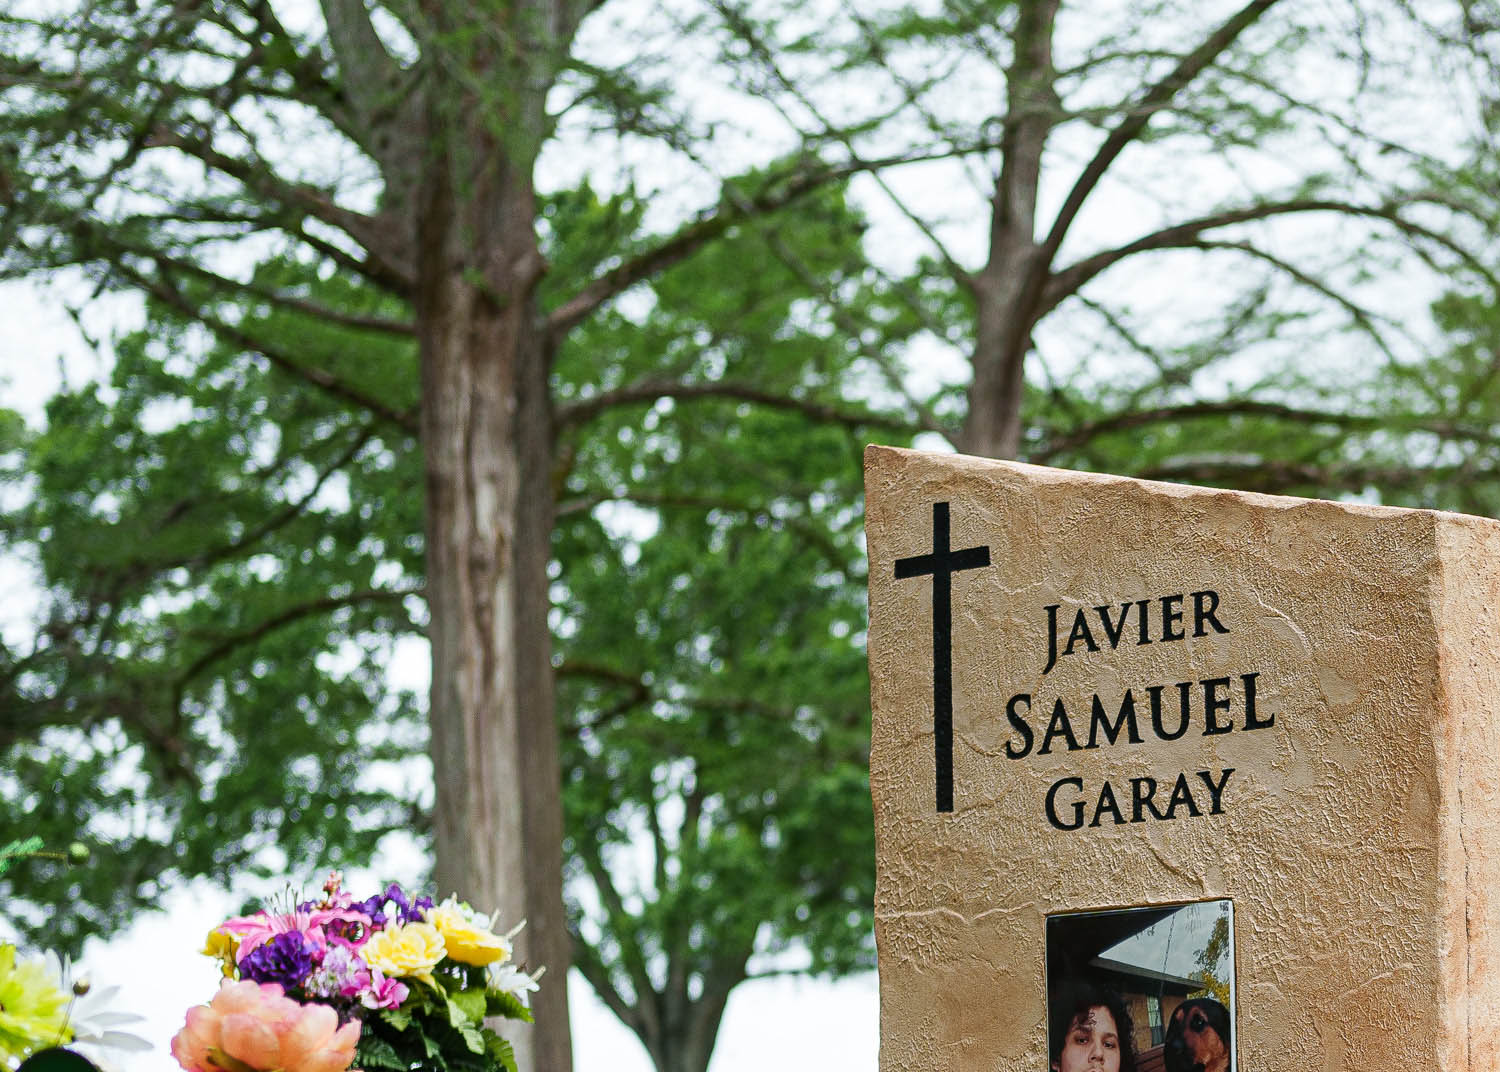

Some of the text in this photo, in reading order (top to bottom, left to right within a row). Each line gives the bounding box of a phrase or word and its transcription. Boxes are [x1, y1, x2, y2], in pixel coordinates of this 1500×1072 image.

[1043, 589, 1231, 676] JAVIER
[1004, 671, 1276, 762] SAMUEL
[1044, 767, 1237, 832] GARAY
